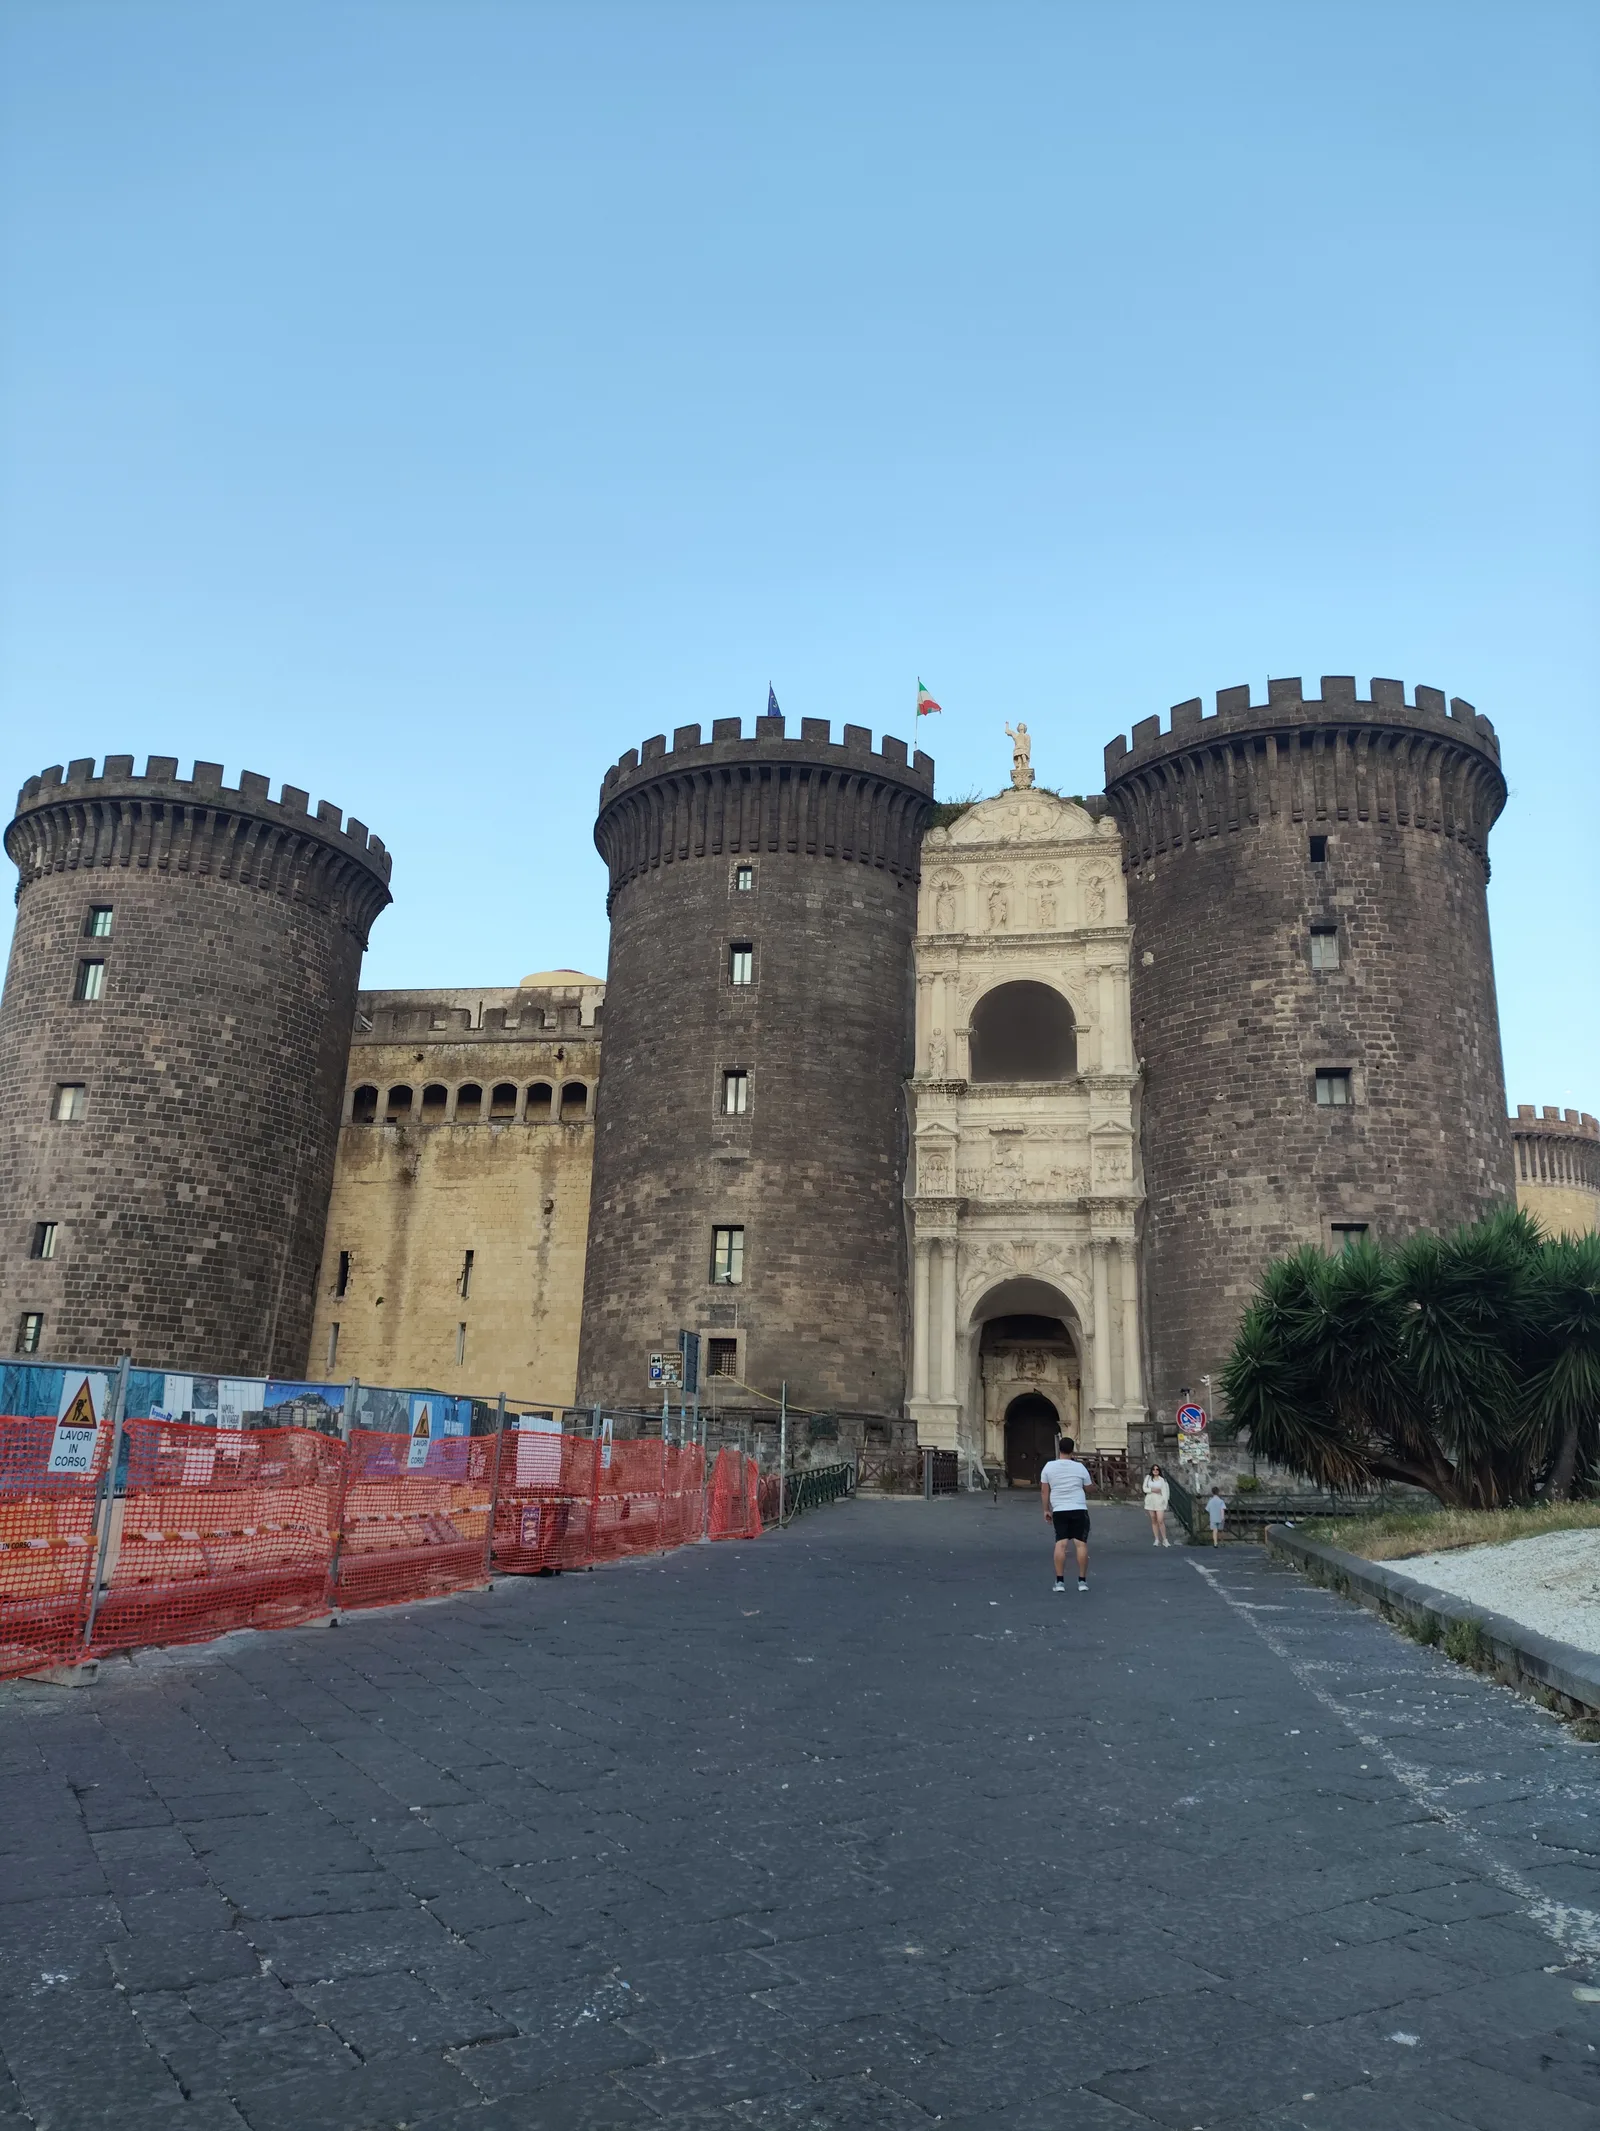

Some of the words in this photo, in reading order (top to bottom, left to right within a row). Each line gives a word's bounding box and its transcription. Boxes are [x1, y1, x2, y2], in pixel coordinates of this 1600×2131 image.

[60, 1430, 92, 1441] LAVORI
[68, 1444, 78, 1453] IN
[54, 1456, 87, 1467] CORSO
[2, 1542, 10, 1550] IN
[11, 1541, 32, 1549] CORSO
